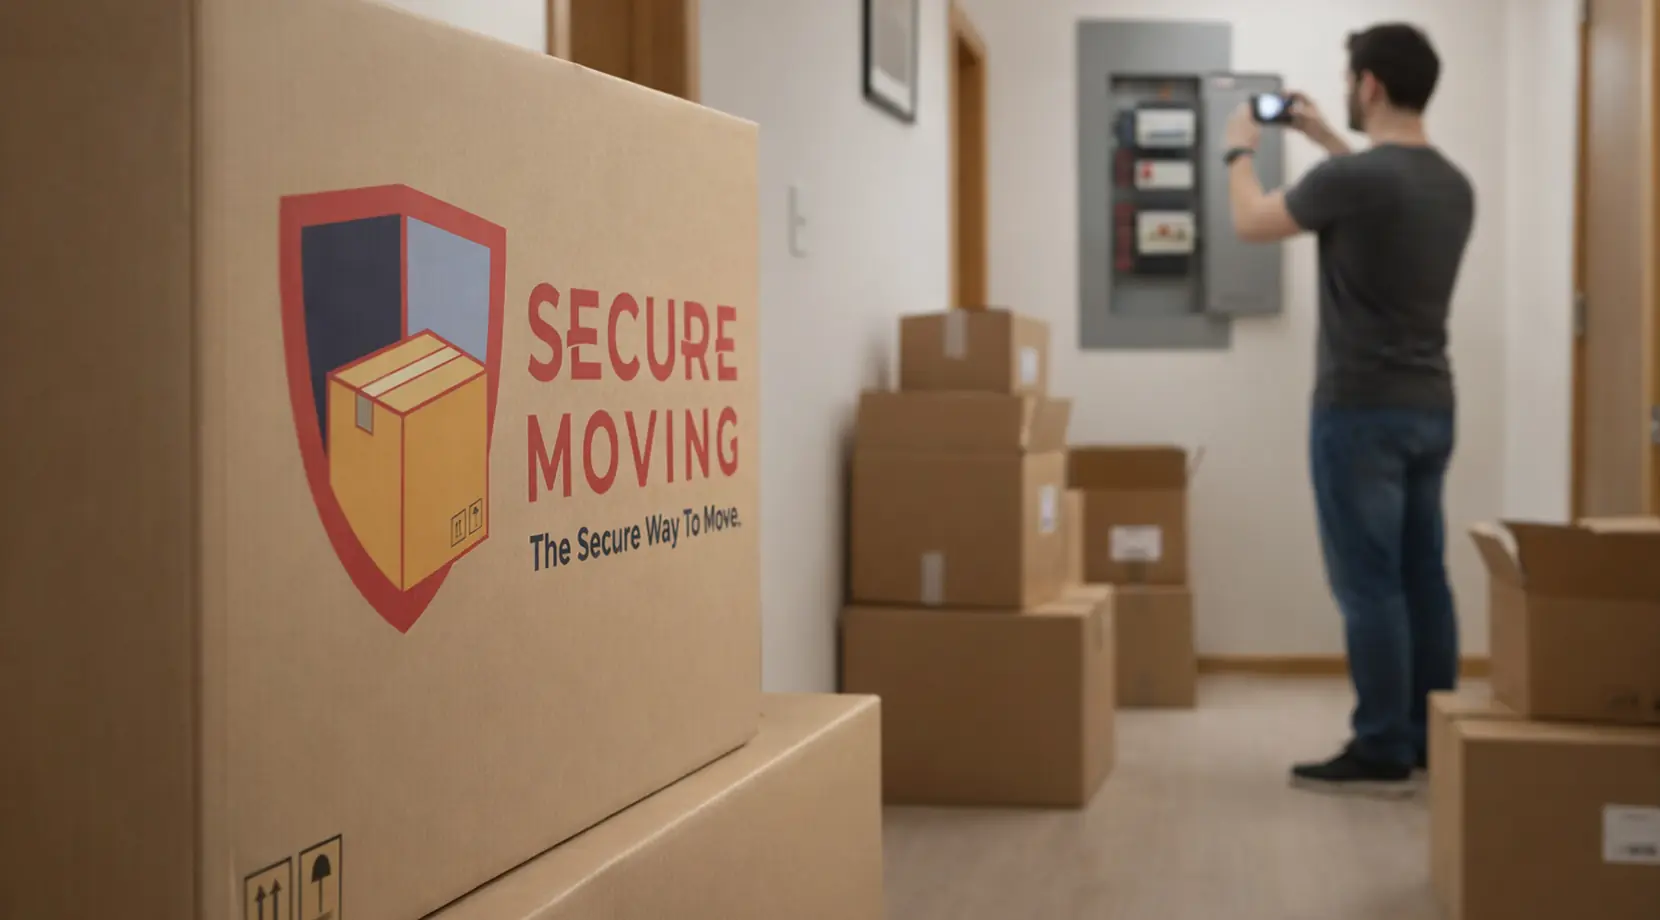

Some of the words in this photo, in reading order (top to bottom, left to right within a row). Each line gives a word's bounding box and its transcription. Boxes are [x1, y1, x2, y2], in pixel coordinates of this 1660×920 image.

[528, 283, 738, 382] SECURE
[527, 406, 738, 503] MOVING
[530, 533, 571, 571] The
[578, 524, 641, 561] Secure
[645, 513, 680, 549] Way
[683, 508, 700, 538] To
[704, 504, 742, 534] Move.
